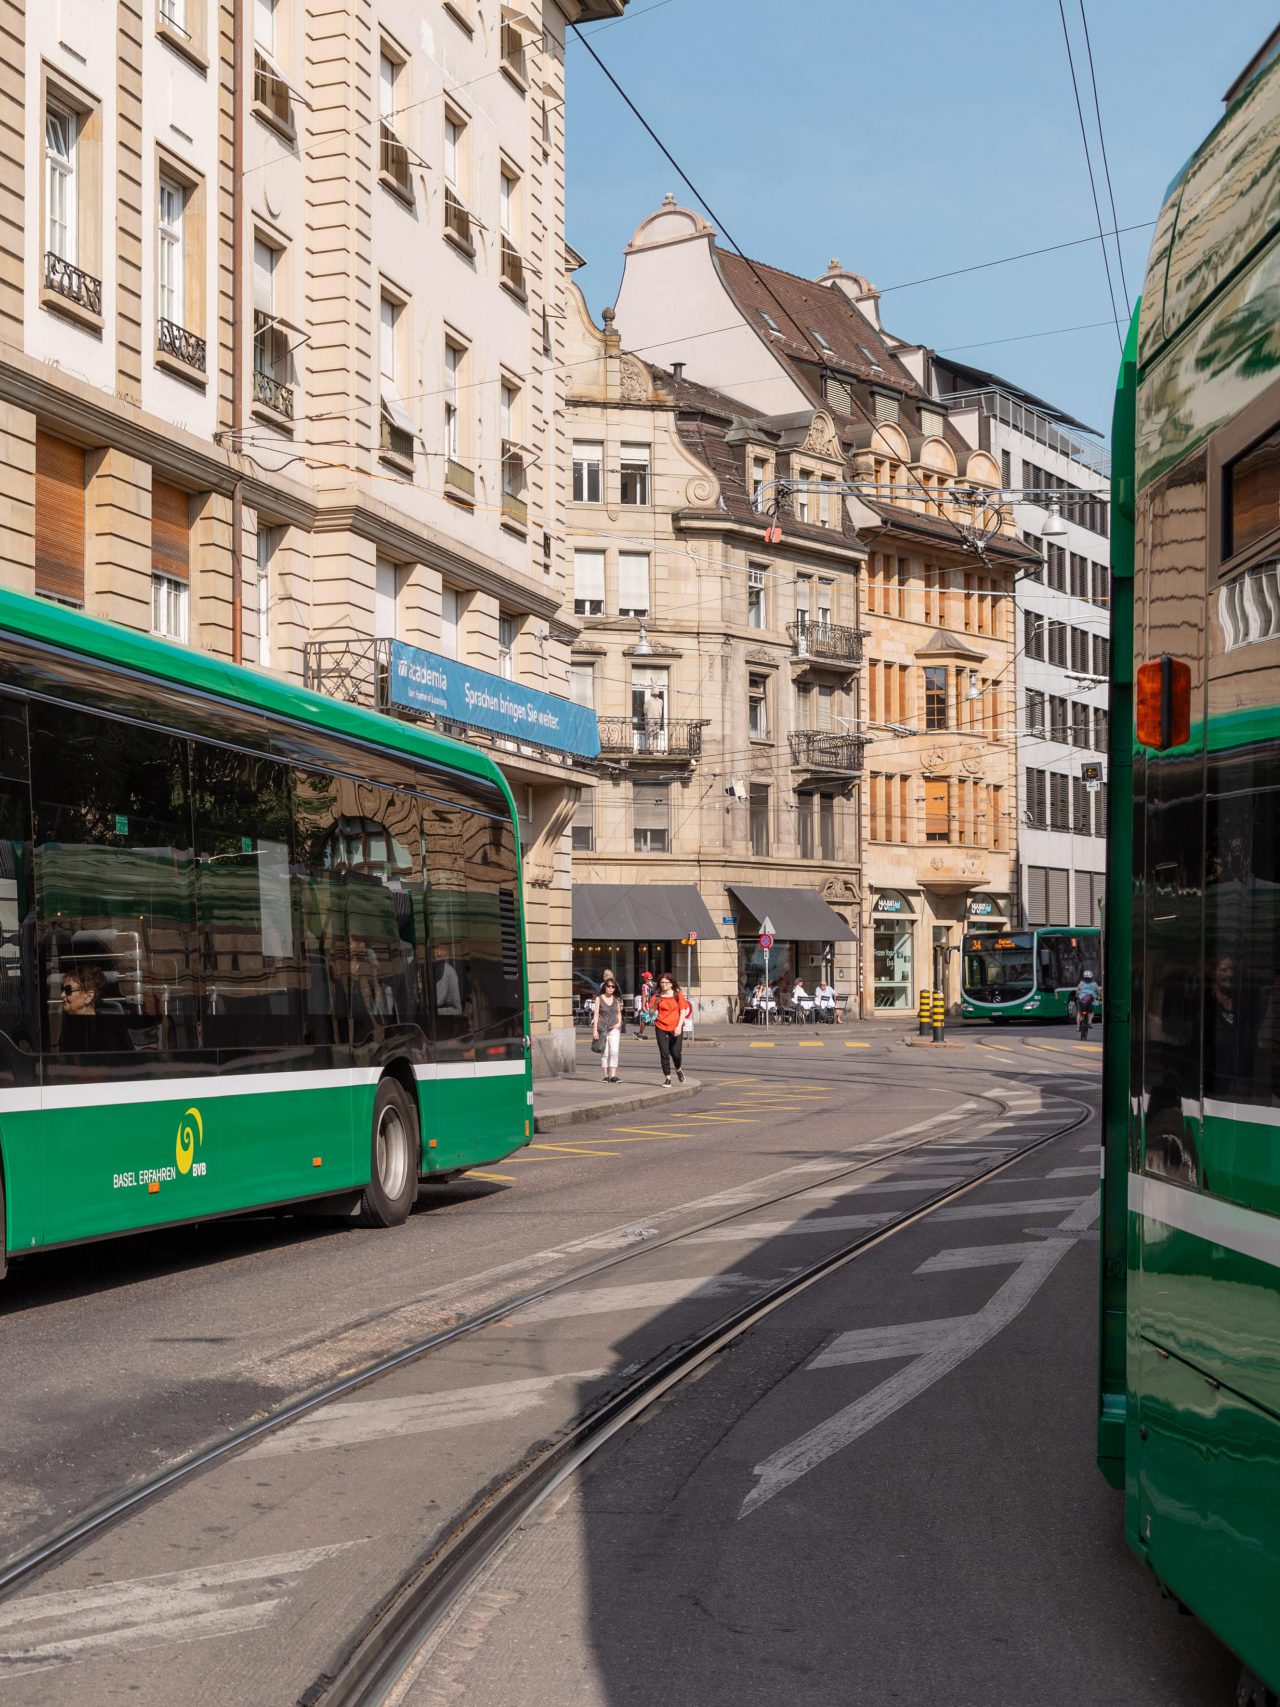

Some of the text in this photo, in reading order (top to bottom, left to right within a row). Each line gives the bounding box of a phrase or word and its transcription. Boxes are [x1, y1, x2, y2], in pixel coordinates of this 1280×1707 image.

[408, 661, 447, 690] academia
[464, 682, 499, 711] Sprachen
[500, 692, 526, 723] bringen
[527, 703, 538, 722] Sie
[113, 1166, 176, 1188] BASEL ERFAHREN
[192, 1162, 206, 1176] BVB
